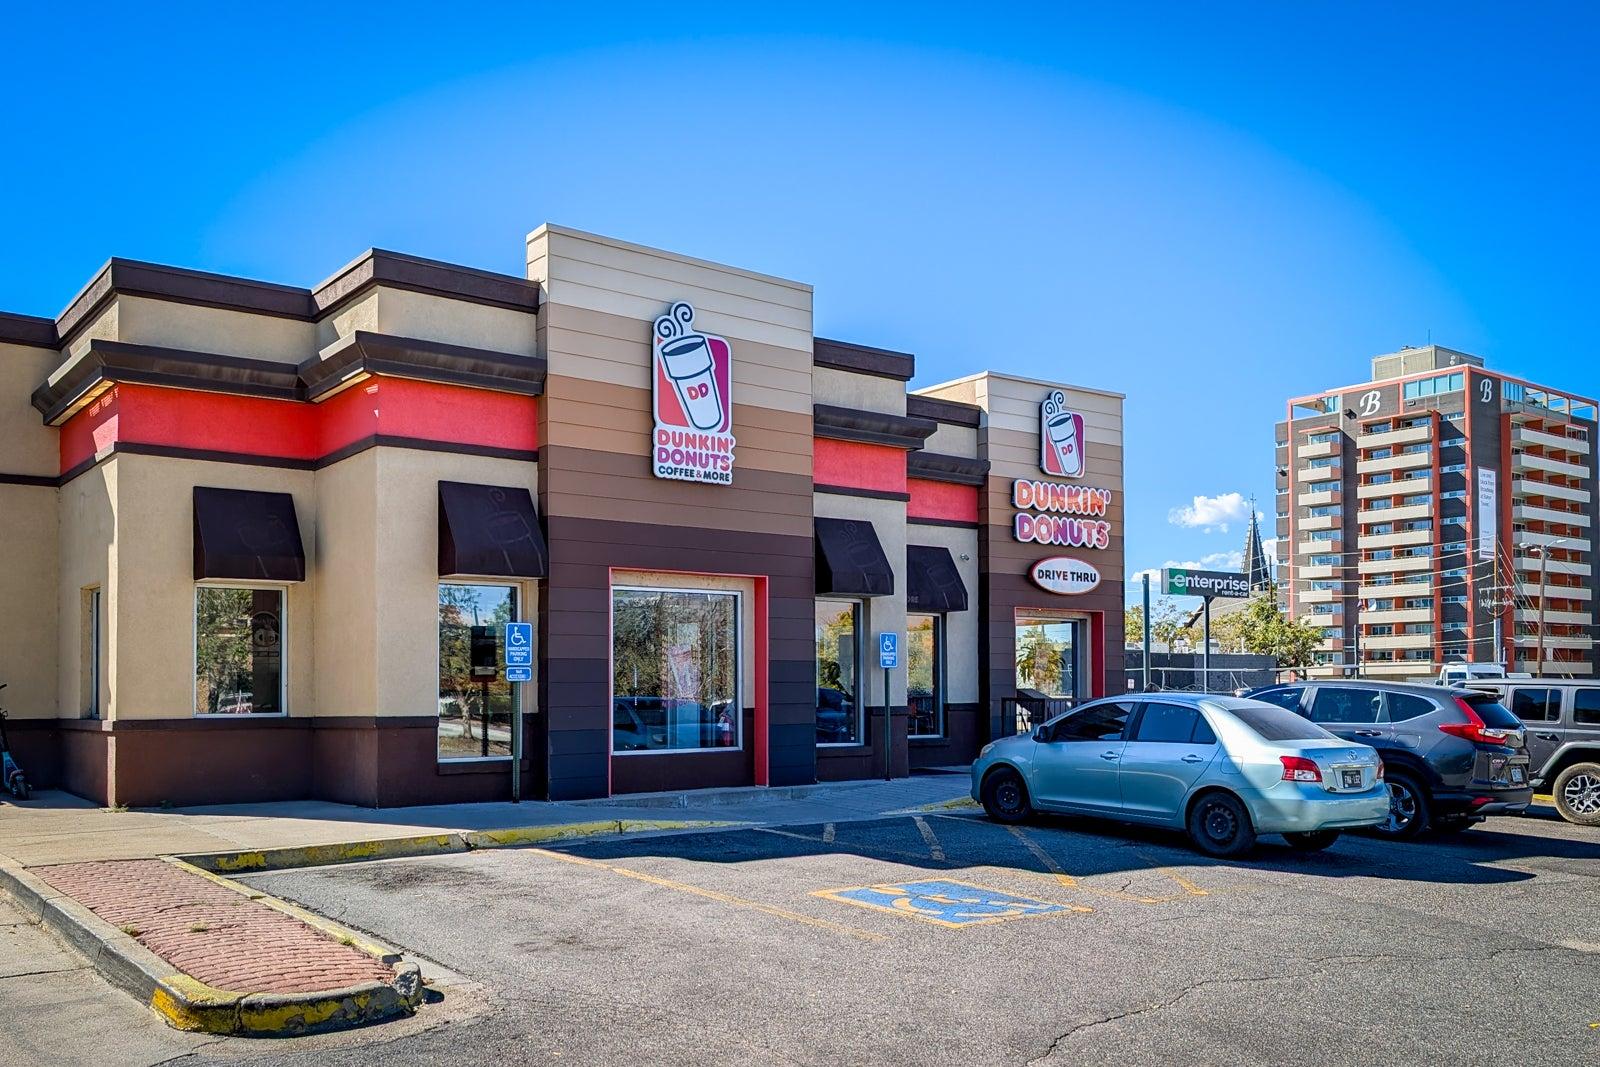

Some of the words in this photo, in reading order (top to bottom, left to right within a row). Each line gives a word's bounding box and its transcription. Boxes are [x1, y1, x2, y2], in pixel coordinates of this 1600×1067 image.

[686, 383, 708, 400] DD
[1480, 378, 1492, 402] B
[1360, 390, 1380, 416] B
[657, 429, 734, 453] DUNKIN'
[1062, 444, 1074, 456] DD
[657, 447, 730, 472] DONUTS
[658, 465, 695, 478] COFFEE
[696, 470, 702, 478] &
[703, 471, 730, 482] MORE
[1016, 480, 1110, 516] DUNKIN'
[1017, 513, 1109, 548] DONUTS
[1038, 569, 1068, 581] DRIVE
[1070, 571, 1097, 583] THRU
[1169, 574, 1249, 592] enterprise
